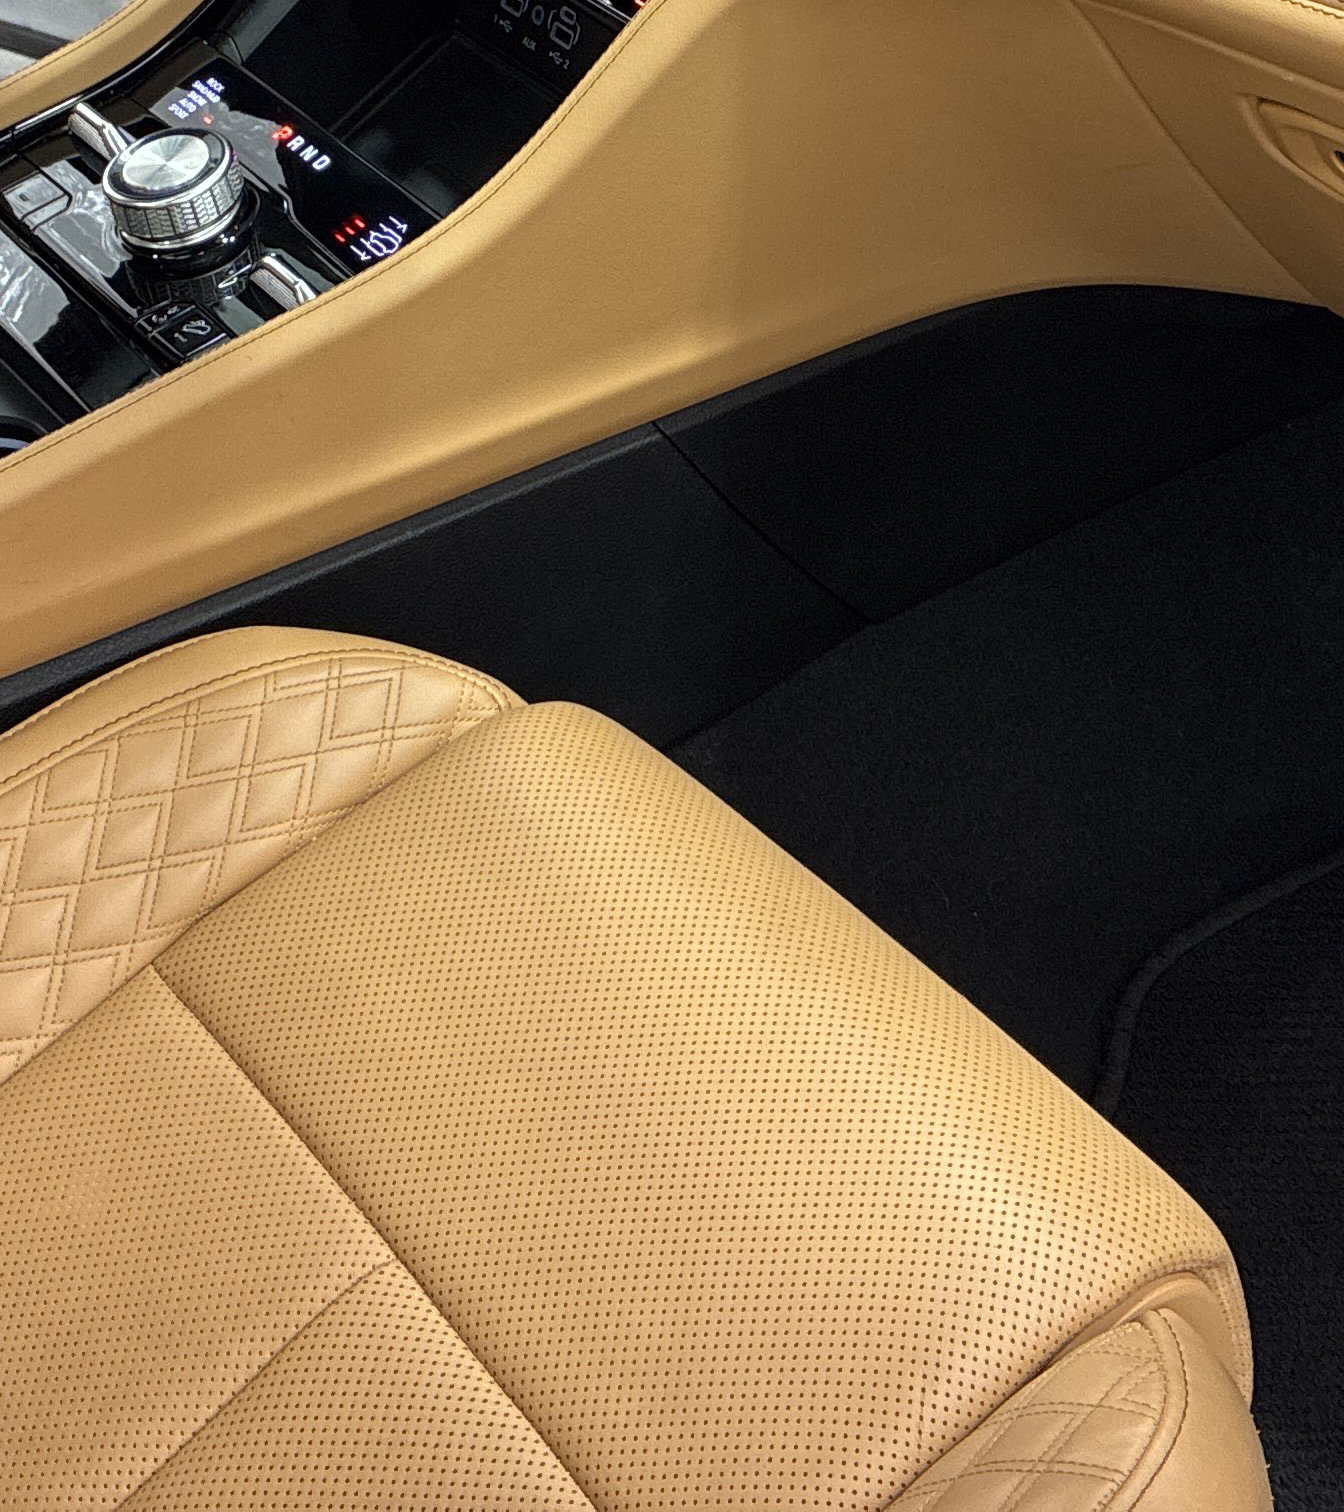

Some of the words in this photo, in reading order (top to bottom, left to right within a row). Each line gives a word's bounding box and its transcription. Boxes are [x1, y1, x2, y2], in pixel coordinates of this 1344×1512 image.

[522, 36, 537, 52] AUX
[206, 77, 225, 93] ROCK
[178, 97, 197, 113] AUTO
[186, 90, 208, 107] SNOW
[167, 103, 190, 120] SPORT
[286, 135, 305, 152] R
[299, 144, 318, 161] N
[312, 154, 331, 171] D
